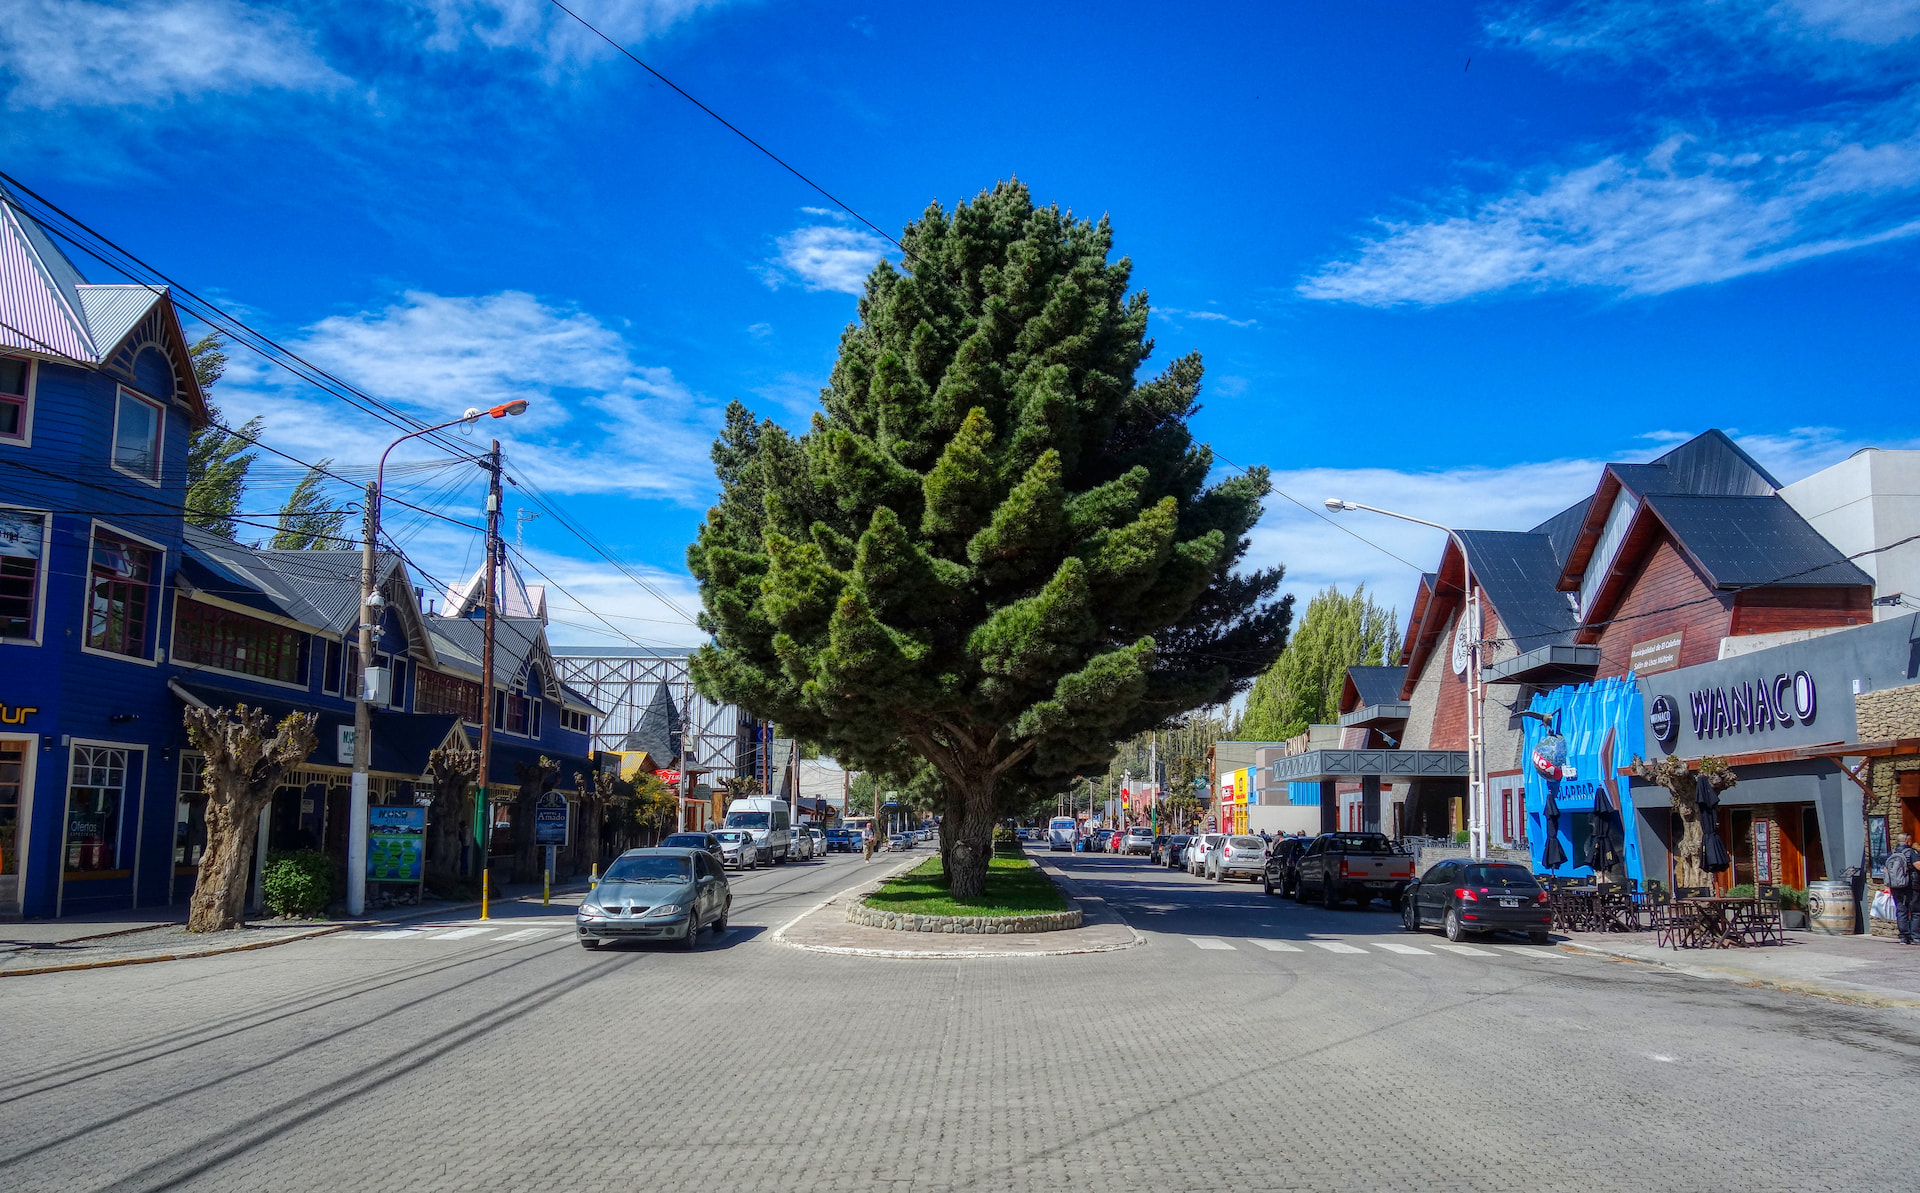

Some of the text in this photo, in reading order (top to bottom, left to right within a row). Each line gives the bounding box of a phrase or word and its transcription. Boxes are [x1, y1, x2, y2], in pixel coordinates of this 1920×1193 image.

[1689, 670, 1816, 736] WANACO
[1650, 711, 1671, 725] WANACO
[537, 811, 566, 821] Amado
[70, 820, 97, 832] Ofertas
